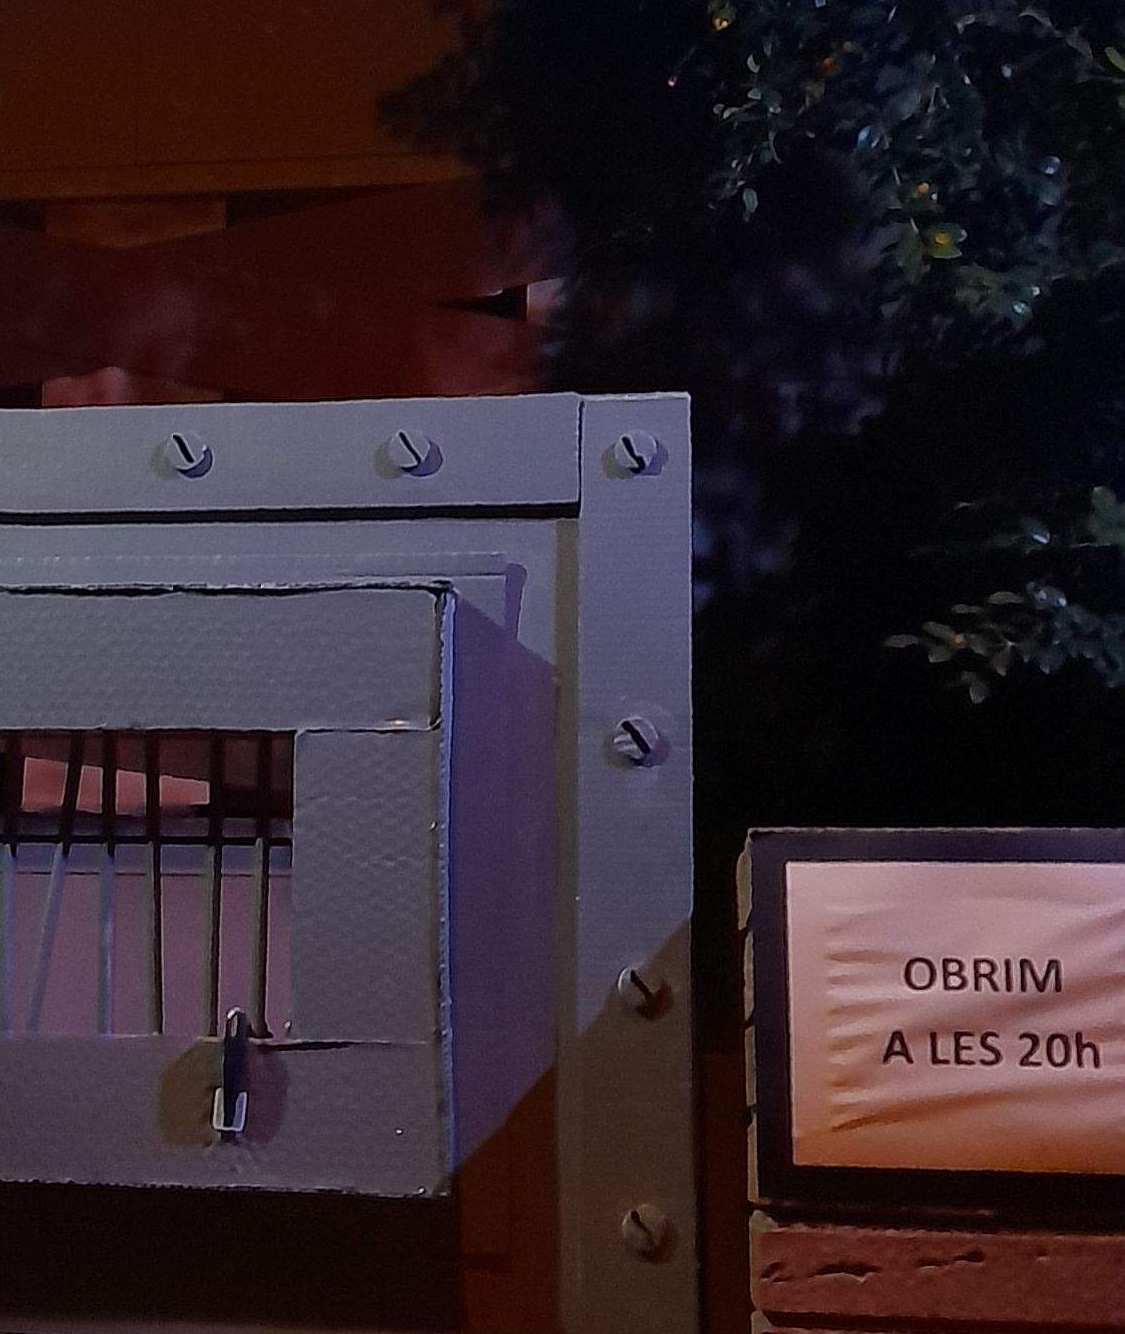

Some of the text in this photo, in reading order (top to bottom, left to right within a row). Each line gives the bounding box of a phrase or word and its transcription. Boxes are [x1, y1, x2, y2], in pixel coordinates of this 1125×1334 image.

[903, 956, 1065, 994] OBRIM
[881, 1029, 1102, 1069] A LES 20h
